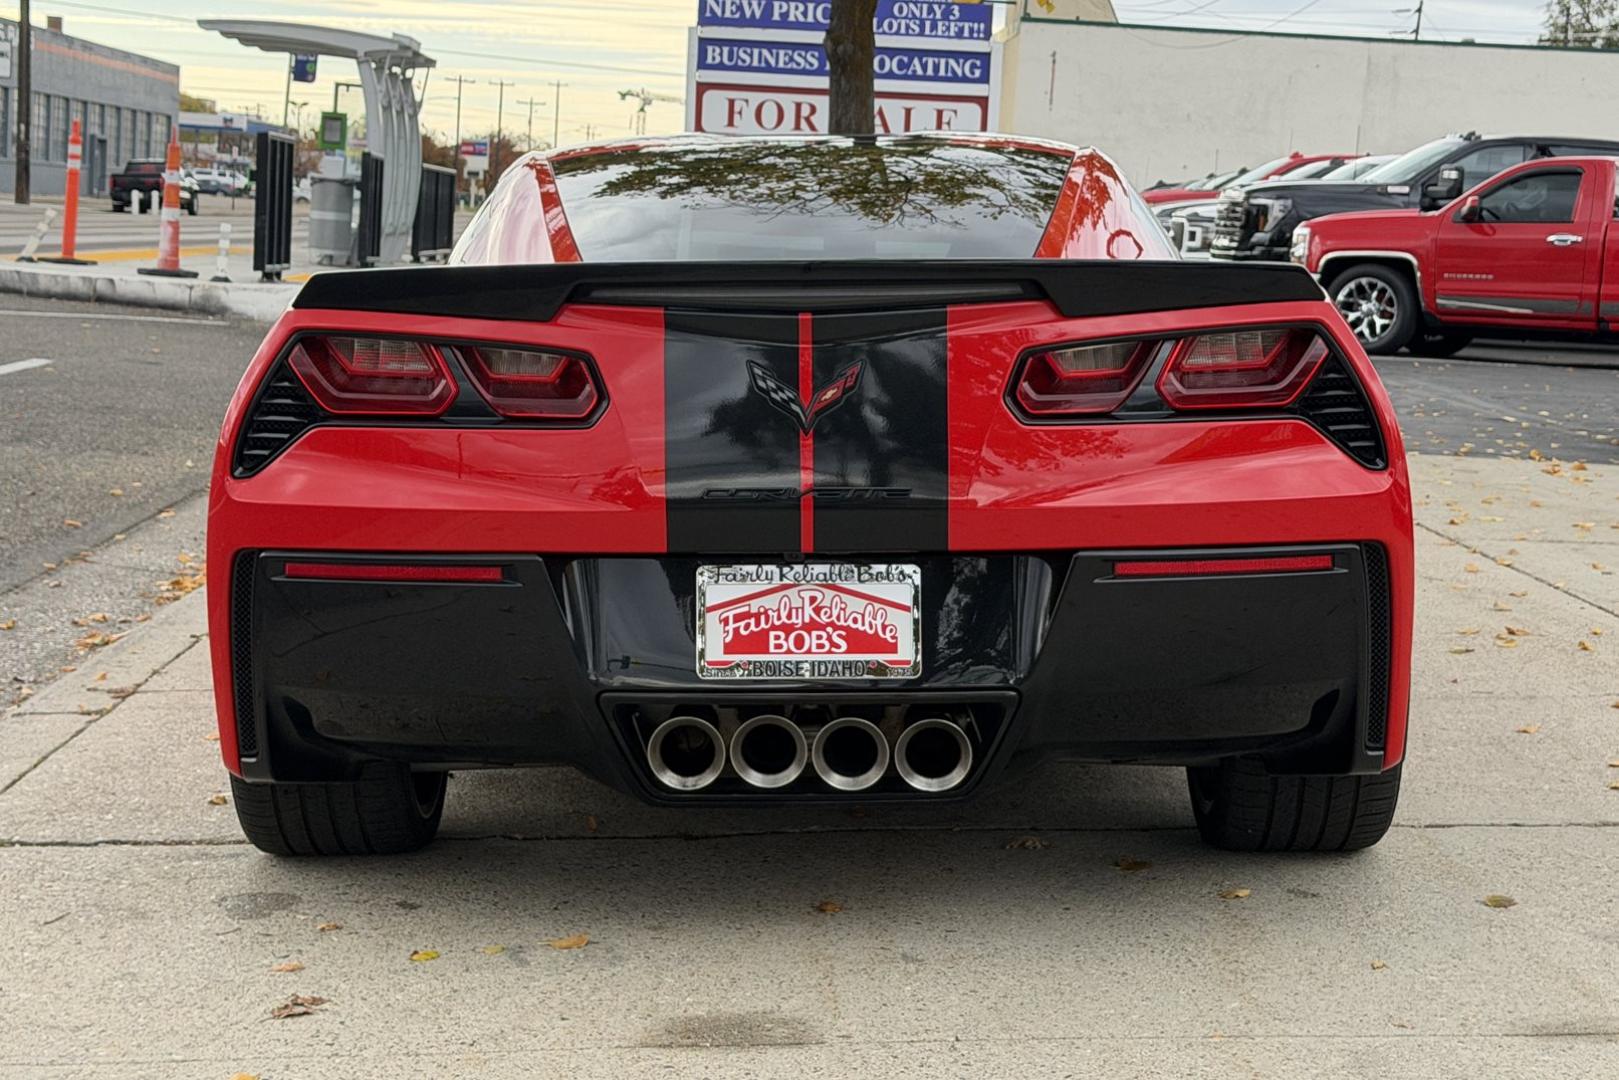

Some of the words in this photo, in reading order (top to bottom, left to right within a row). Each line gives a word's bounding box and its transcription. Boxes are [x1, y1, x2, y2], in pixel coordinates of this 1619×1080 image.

[705, 0, 765, 20] NEW
[771, 1, 832, 23] PRIC
[892, 2, 945, 19] ONLY
[949, 4, 960, 19] 3
[873, 17, 920, 35] LOTS
[924, 20, 985, 38] LEFT!!
[705, 45, 819, 71] BUSINESS
[725, 97, 818, 132] FOR
[873, 104, 958, 135] ALE
[711, 564, 774, 584] Fairly
[776, 565, 855, 583] Reliable
[856, 565, 907, 583] Bob's
[718, 594, 802, 643] Fairly
[797, 587, 899, 643] Reliable
[768, 627, 849, 654] BOB'S
[752, 660, 804, 678] BOISE
[812, 660, 866, 677] IDAHO
